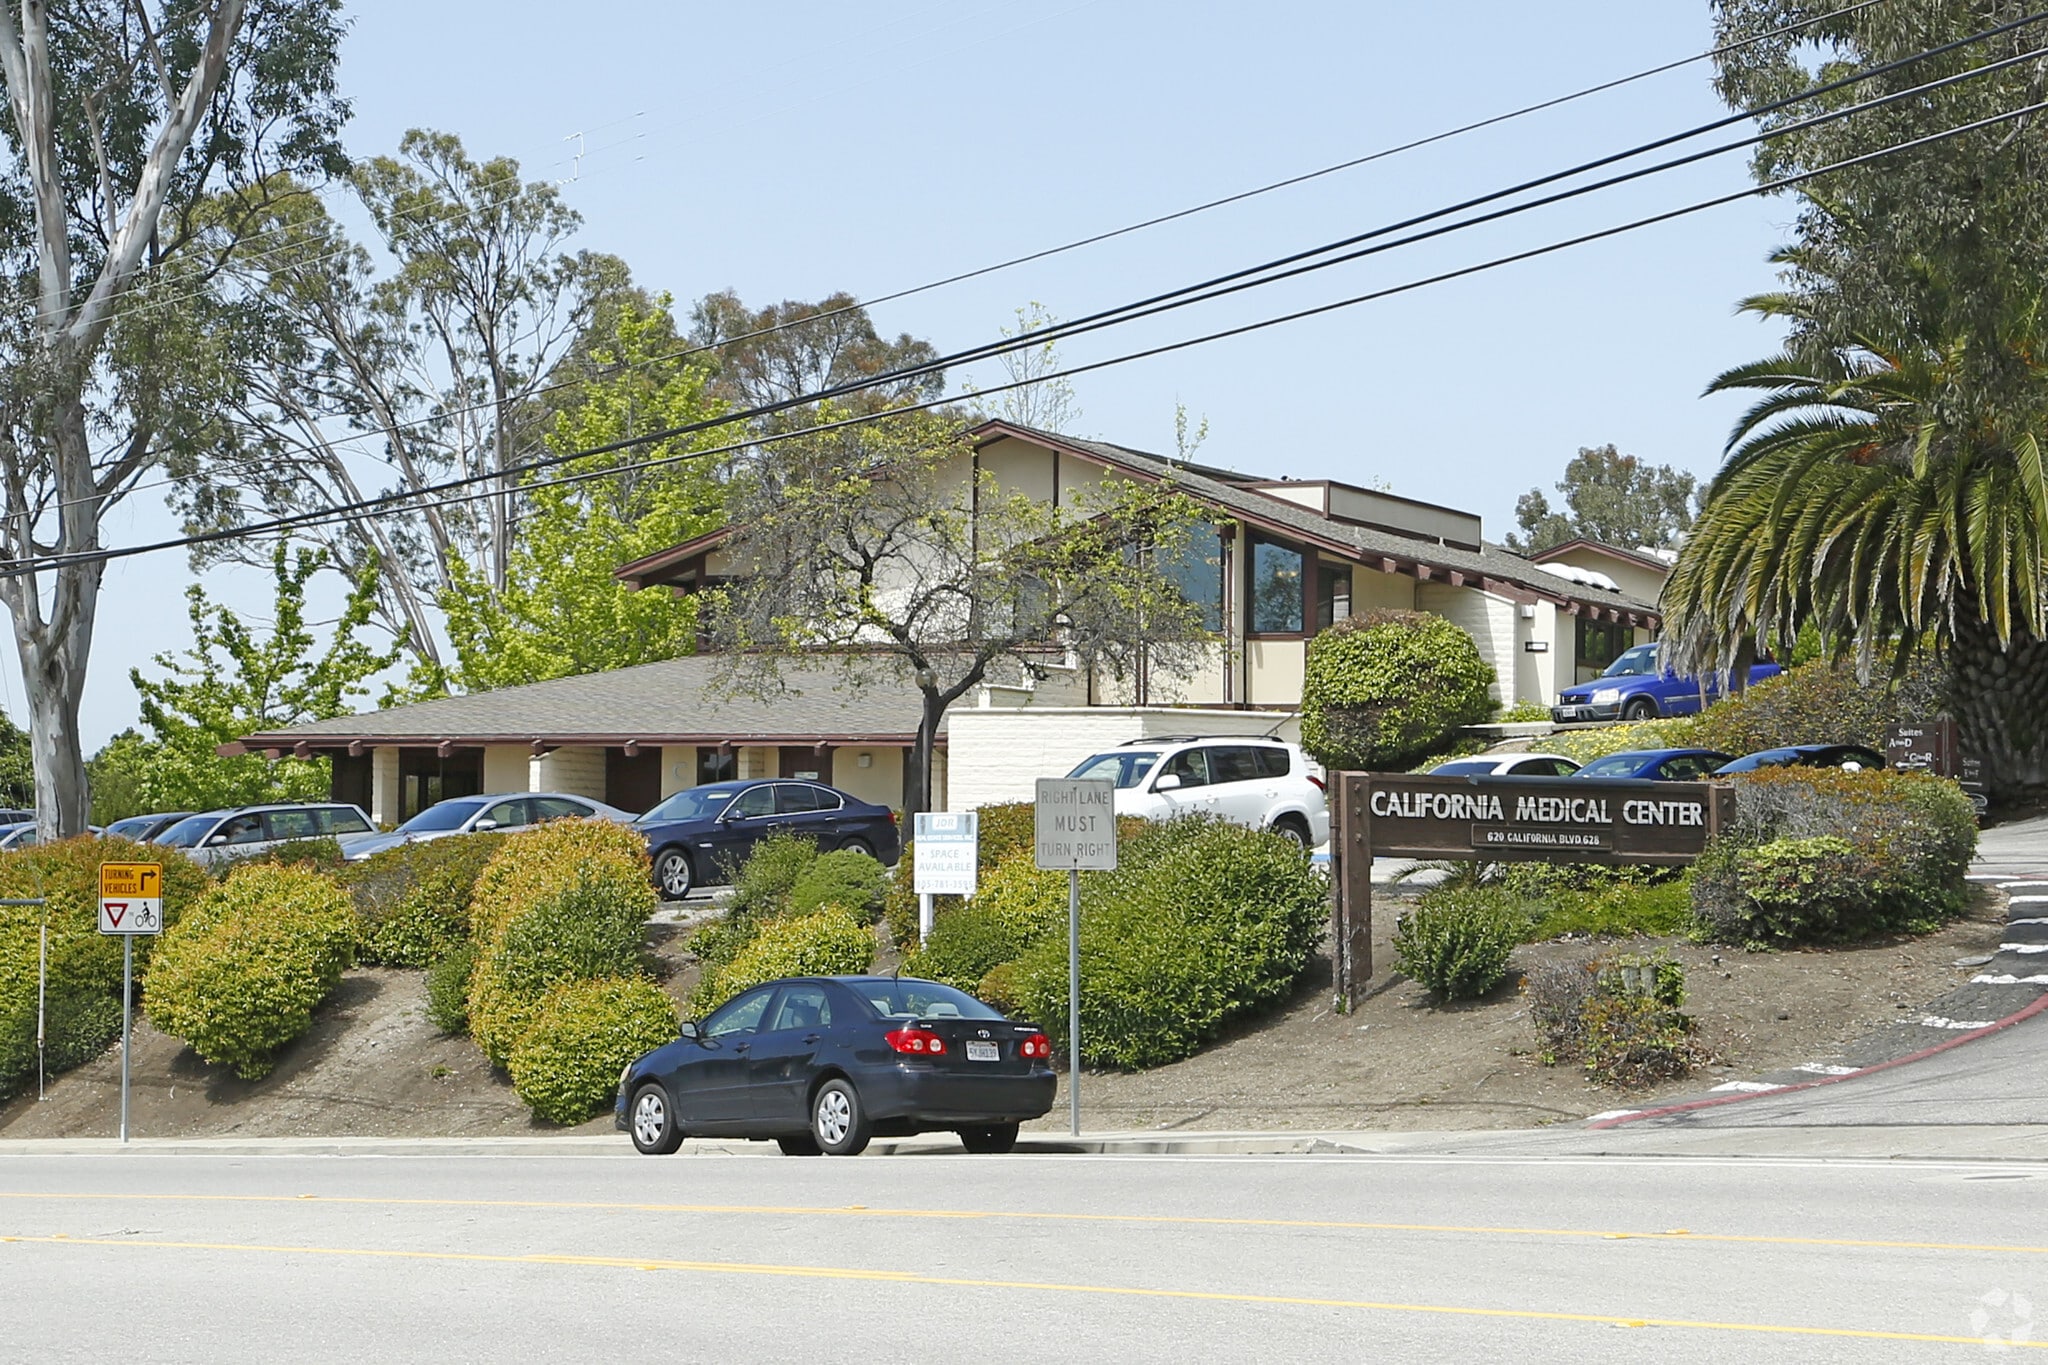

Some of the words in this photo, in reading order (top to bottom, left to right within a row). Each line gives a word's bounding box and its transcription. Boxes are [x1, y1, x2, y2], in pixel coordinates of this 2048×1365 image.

[1898, 727, 1924, 737] Suites
[1888, 738, 1896, 748] A
[1904, 738, 1913, 747] D
[1925, 752, 1932, 762] R
[1041, 791, 1076, 804] RIGHT
[1080, 791, 1109, 805] LANE
[1370, 790, 1504, 820] CALIFORNIA
[1515, 796, 1612, 824] MEDICAL
[1622, 800, 1704, 826] CENTER
[935, 818, 954, 828] JDR
[1055, 816, 1096, 832] MUST
[1487, 832, 1504, 842] 620
[1507, 832, 1556, 844] CALIFORNIA
[1582, 835, 1600, 845] 628
[930, 848, 960, 859] SPACE
[1040, 843, 1070, 856] TURN
[1077, 843, 1110, 857] RIGHT
[918, 862, 972, 872] AVAILABLE
[105, 869, 134, 880] TURNING
[104, 883, 137, 894] VEHICLES
